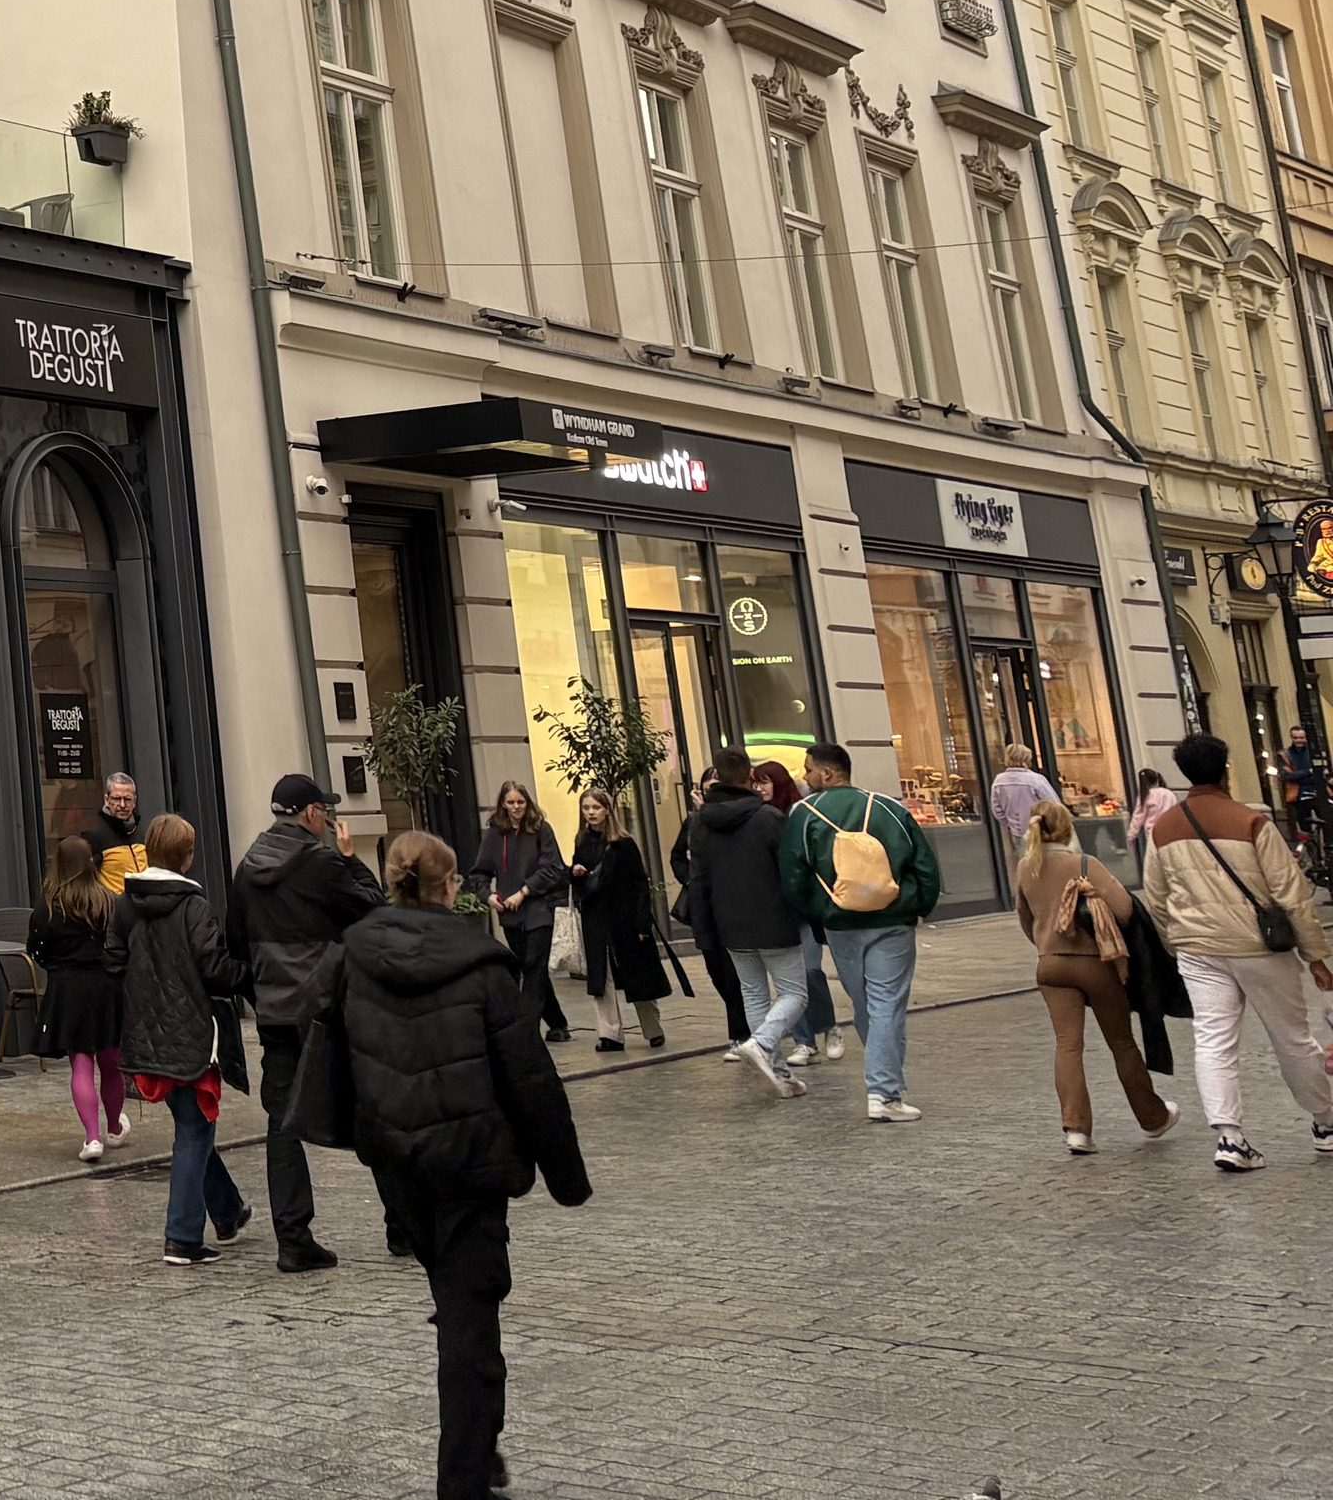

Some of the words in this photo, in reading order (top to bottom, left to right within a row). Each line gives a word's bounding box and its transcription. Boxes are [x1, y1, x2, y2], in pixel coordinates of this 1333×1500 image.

[15, 318, 124, 363] TRATTORIA
[29, 349, 114, 393] DEGUSTI
[563, 414, 607, 433] WYNDHAM
[607, 421, 635, 438] GRAND
[954, 492, 988, 525] flying
[752, 656, 765, 664] ON
[766, 655, 793, 664] EARTH
